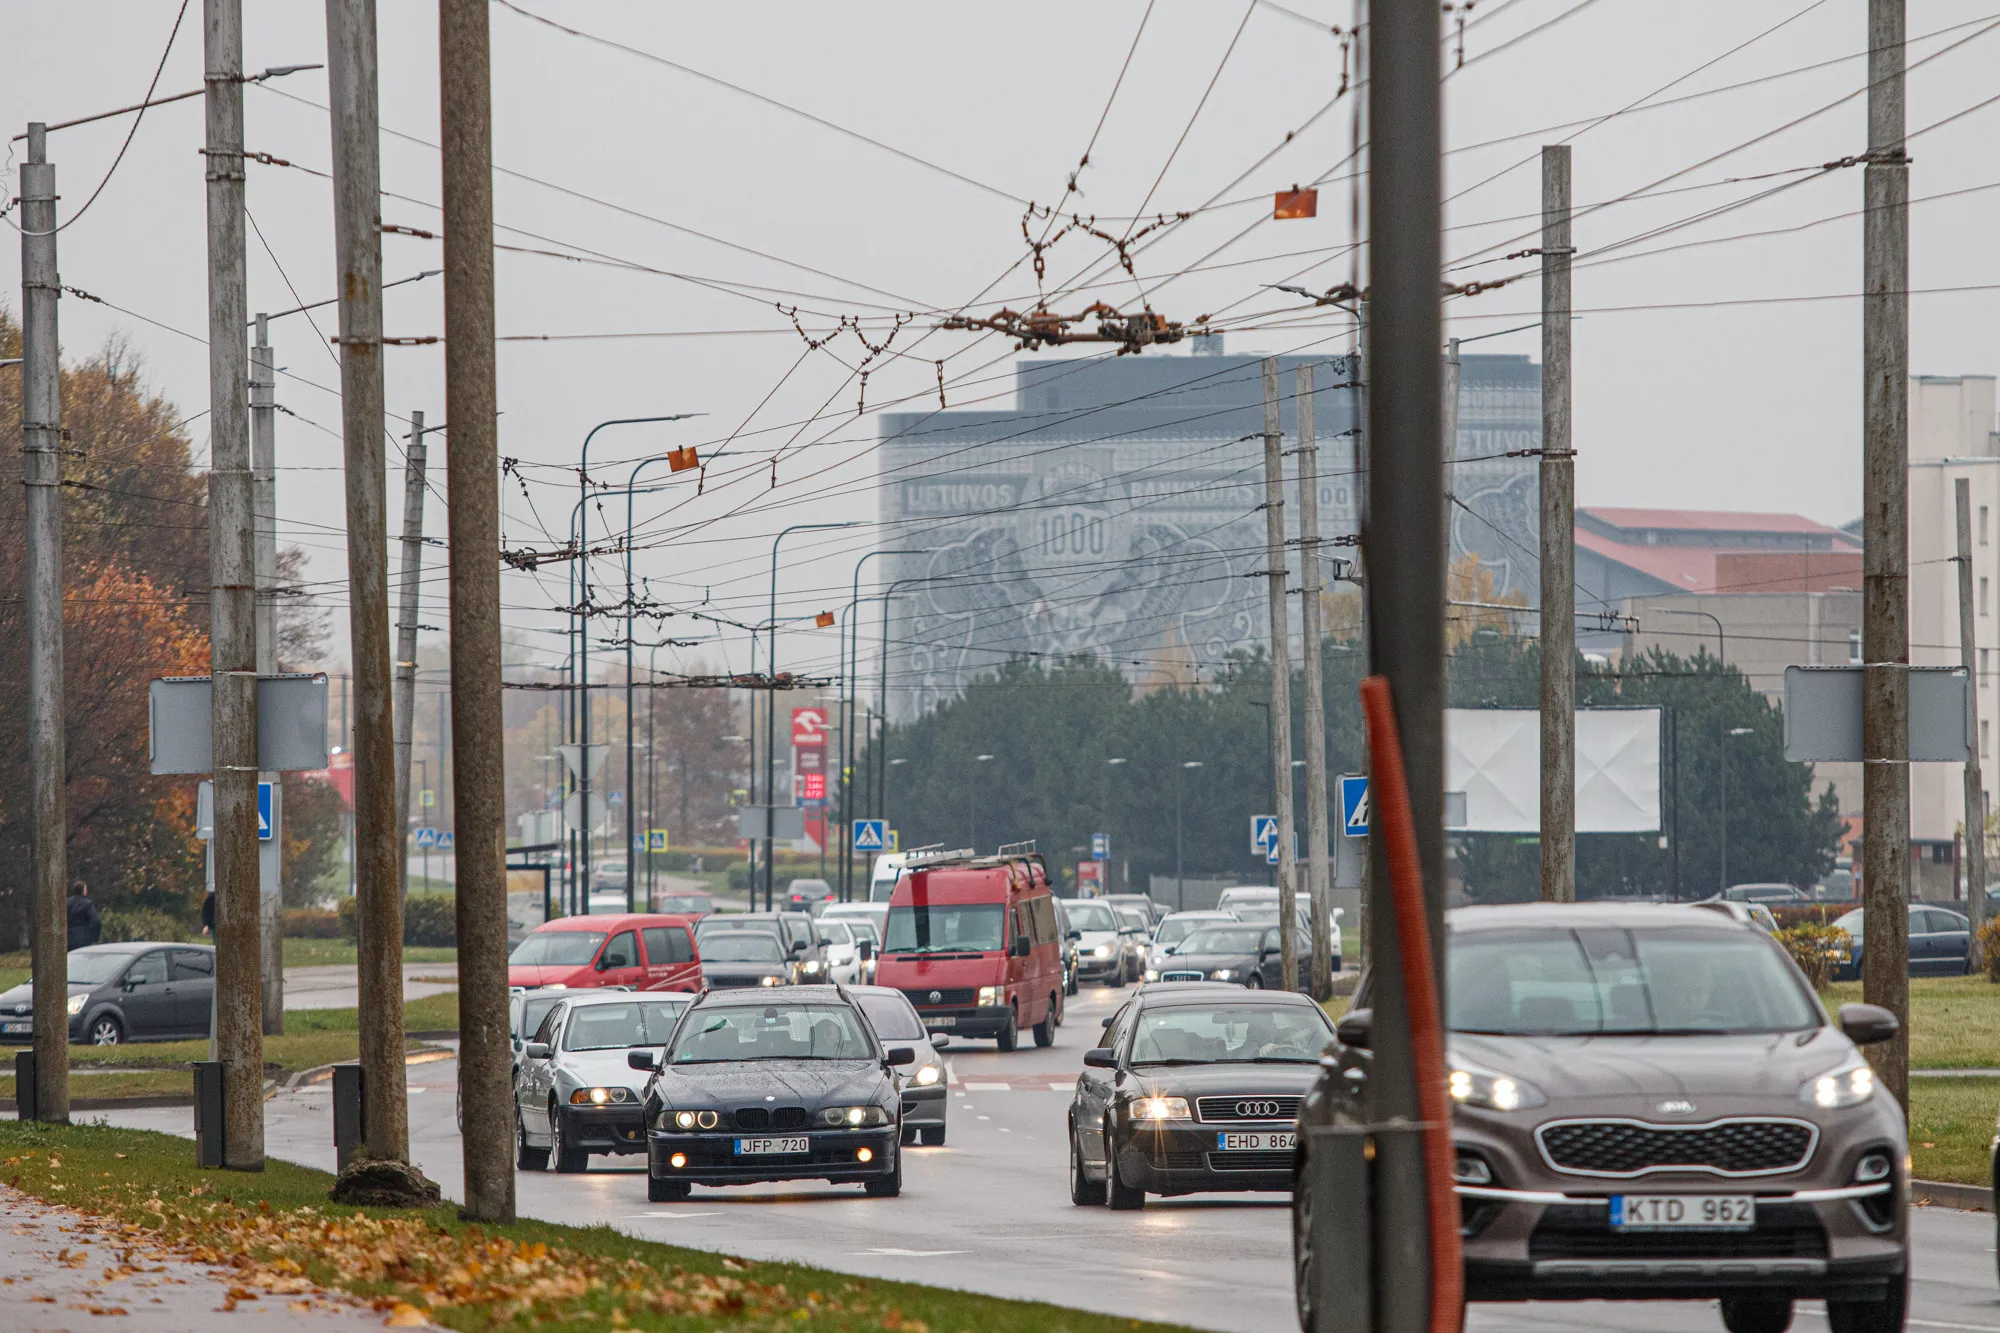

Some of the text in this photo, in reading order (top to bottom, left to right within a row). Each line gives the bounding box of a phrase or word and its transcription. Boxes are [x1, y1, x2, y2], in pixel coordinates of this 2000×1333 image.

[1457, 429, 1541, 450] ETUVOS
[908, 480, 1256, 508] LIETUVOS BANKNOTAS
[1041, 512, 1104, 555] 1000
[743, 1139, 807, 1153] JFP 720
[1227, 1135, 1296, 1148] EHD 864
[1627, 1198, 1750, 1222] KTD 962
